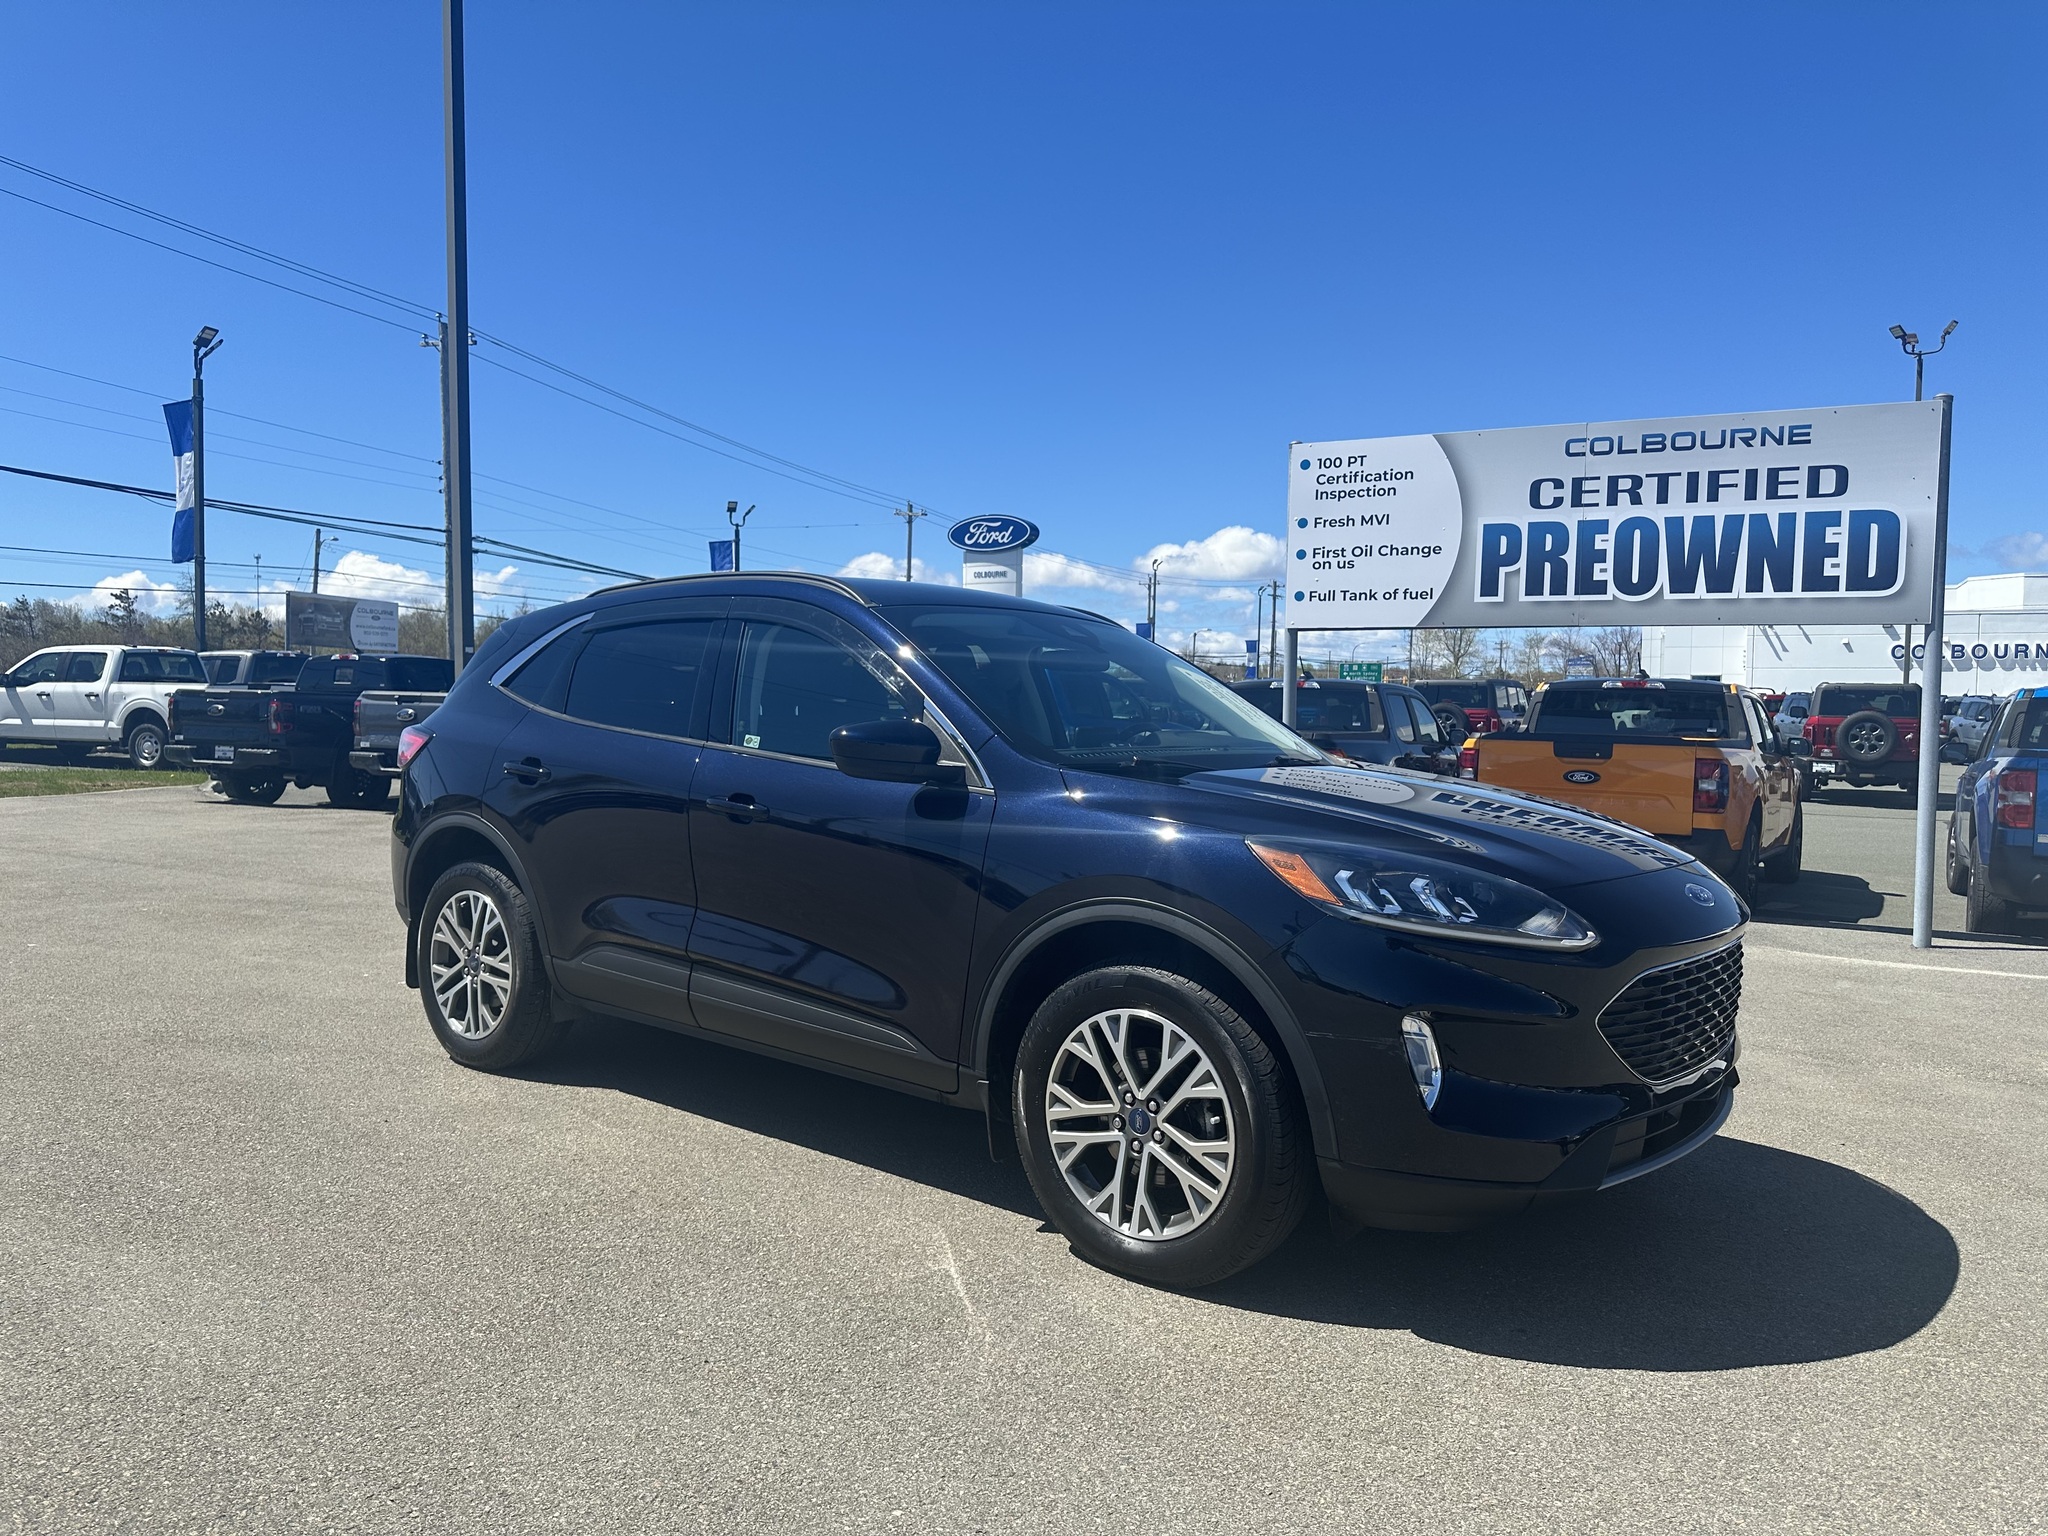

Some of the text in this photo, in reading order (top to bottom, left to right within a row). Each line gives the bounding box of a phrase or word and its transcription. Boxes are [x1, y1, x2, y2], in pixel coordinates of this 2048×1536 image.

[1564, 423, 1813, 458] COLBOURNE
[1317, 455, 1368, 470] 100 PT
[1315, 468, 1415, 486] Certification
[1314, 485, 1397, 502] Inspection
[1527, 464, 1850, 510] CERTIFIED
[1313, 513, 1391, 529] Fresh MVI
[964, 520, 1014, 545] Ford
[1311, 544, 1443, 559] First Oil Change
[1477, 508, 1903, 599] PREOWNED
[1311, 559, 1356, 570] on us
[974, 571, 1008, 579] COLBOURNE
[1308, 587, 1434, 602] Full Tank of fuel
[357, 607, 394, 616] COLBOURNE
[1890, 643, 2048, 660] COBOURN
